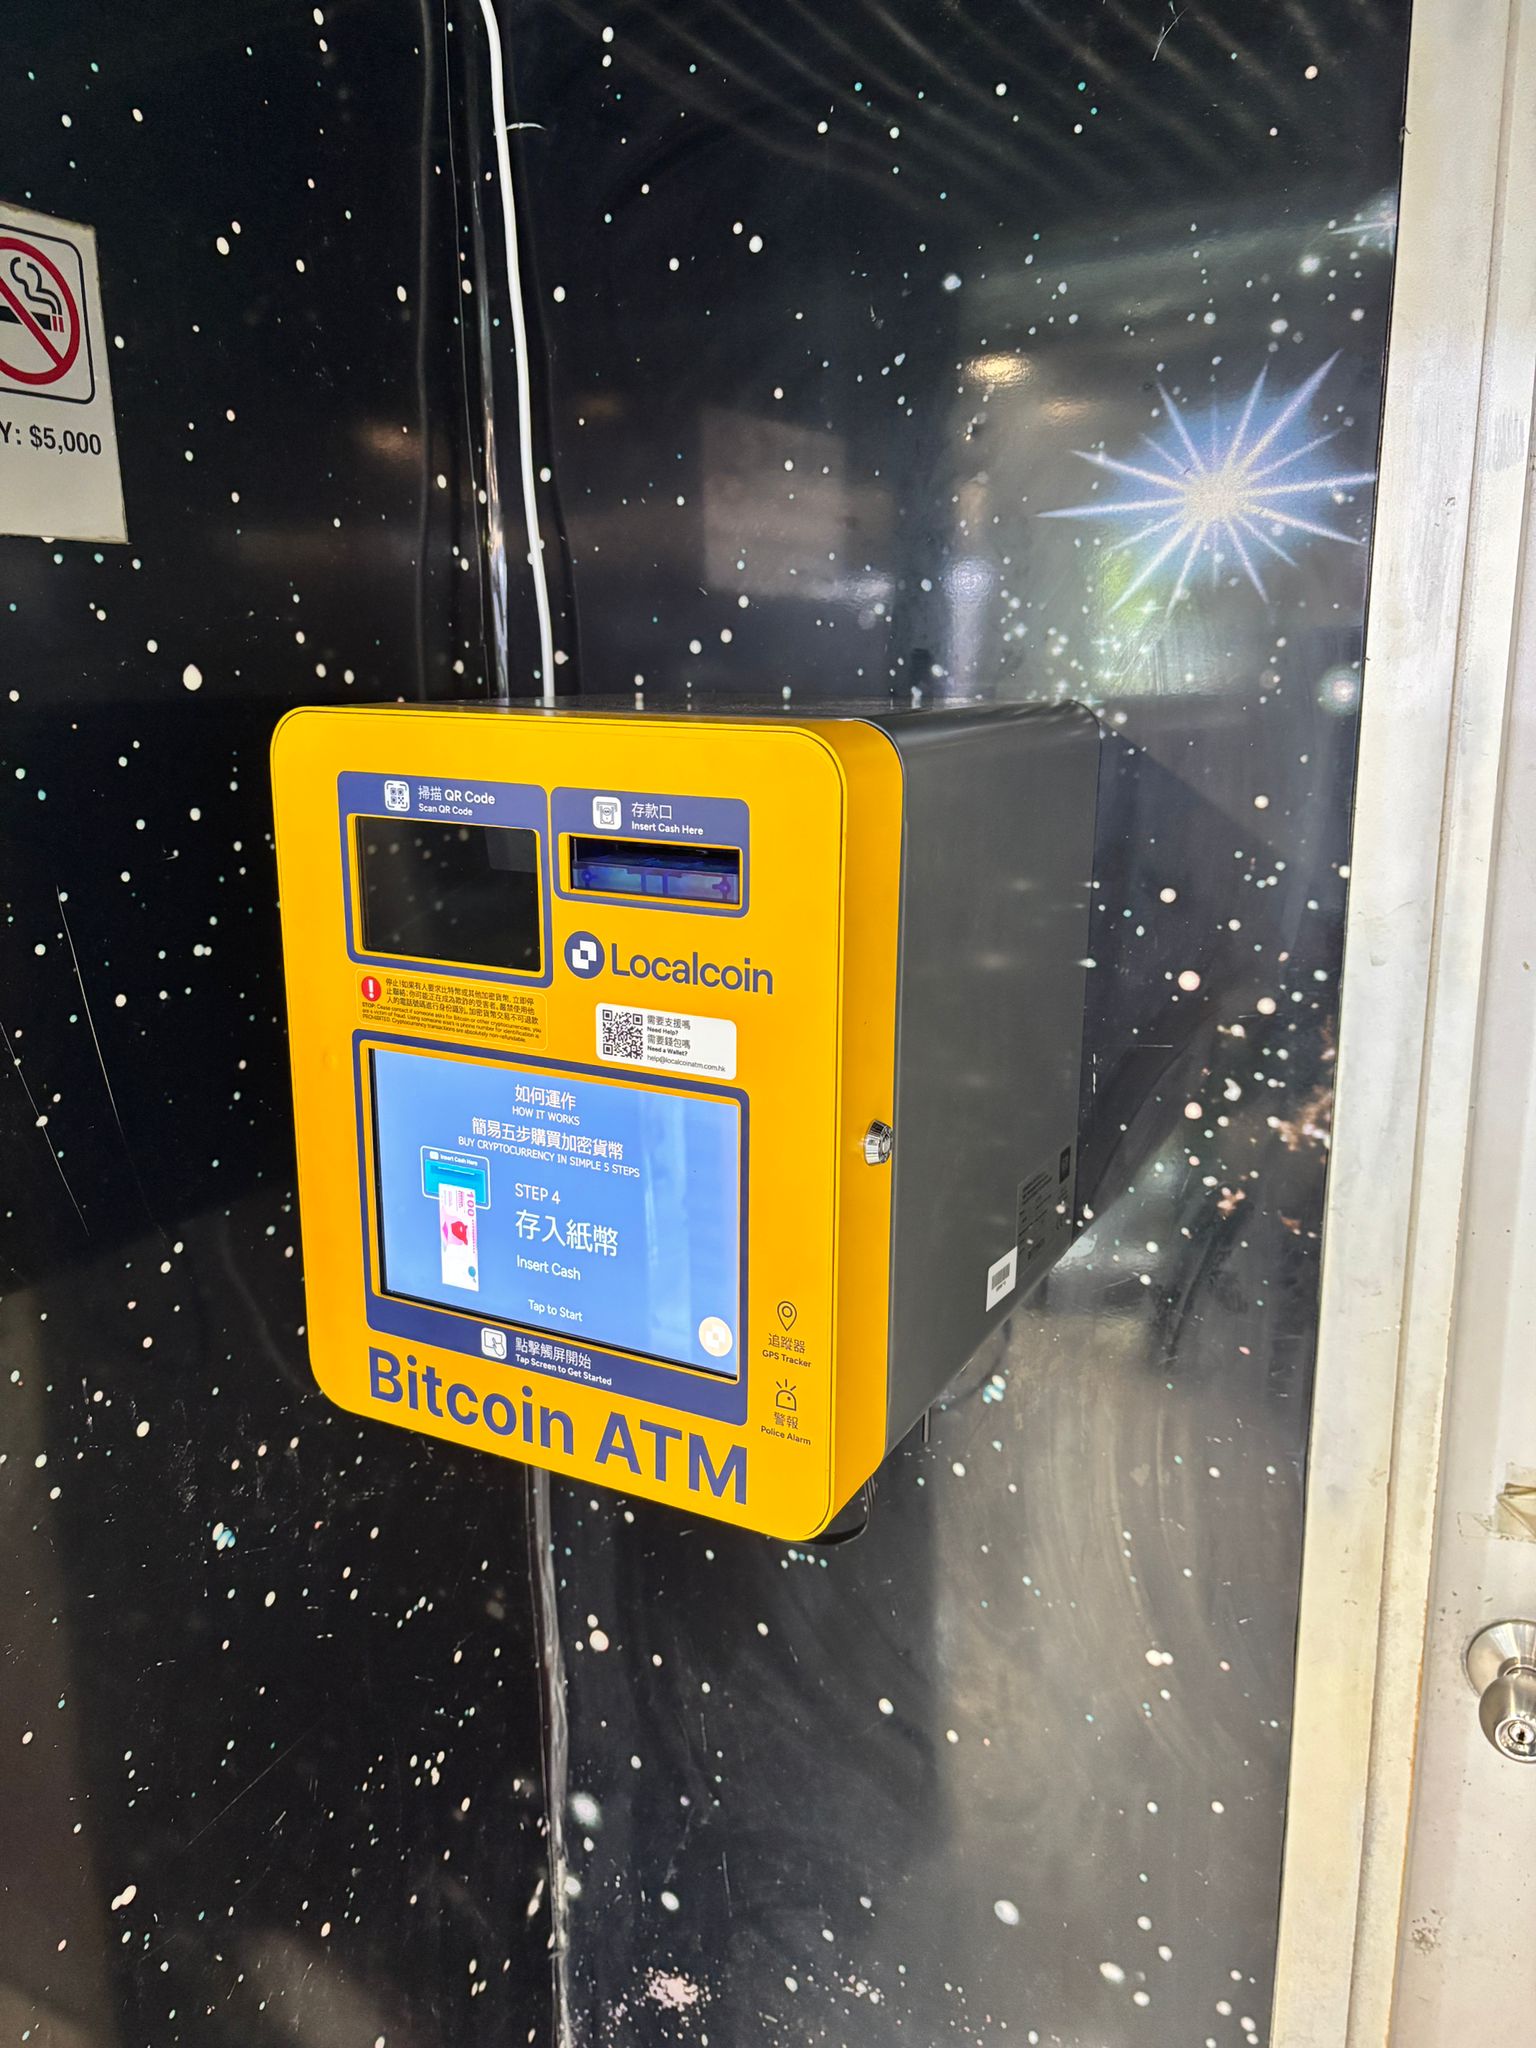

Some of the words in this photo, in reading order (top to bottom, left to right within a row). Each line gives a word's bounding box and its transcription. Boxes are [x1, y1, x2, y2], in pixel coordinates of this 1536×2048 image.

[29, 424, 102, 455] $5,000
[418, 785, 442, 801] 掃描
[444, 789, 463, 803] QR
[464, 790, 496, 805] Code
[418, 803, 437, 813] Scan
[438, 805, 451, 814] QR
[452, 806, 473, 816] Code
[631, 801, 672, 820] 存款口
[631, 820, 656, 832] Insert
[658, 823, 680, 834] Cash
[682, 825, 704, 836] Here
[611, 943, 773, 995] Localcoin
[647, 1014, 691, 1030] 需要支援嗎
[647, 1026, 662, 1034] Need
[663, 1028, 678, 1036] Help?
[647, 1045, 662, 1053] Need
[667, 1048, 688, 1057] Wallet?
[647, 1055, 726, 1073] help@localcoinatm.com.hk
[514, 1084, 576, 1111] 如何運作
[512, 1105, 534, 1118] HOW
[536, 1110, 546, 1120] IT
[547, 1112, 580, 1126] WORKS
[472, 1117, 624, 1160] 簡易五步購買加密貨幣
[458, 1136, 475, 1147] BUY
[477, 1139, 555, 1163] CRYPTOCURRENCY
[557, 1153, 567, 1164] IN
[569, 1156, 601, 1171] SIMPLE
[603, 1162, 610, 1173] 5
[611, 1164, 640, 1178] STEPS
[467, 1191, 475, 1217] 100
[515, 1183, 549, 1202] STEP
[551, 1190, 561, 1205] 4
[515, 1209, 619, 1257] 存入紙幣
[516, 1254, 549, 1273] Insert
[551, 1262, 581, 1281] Cash
[528, 1298, 545, 1314] Tap
[547, 1304, 557, 1316] to
[559, 1306, 583, 1322] Start
[515, 1337, 592, 1370] 點擊觸屏開始
[768, 1333, 806, 1354] 追蹤器
[762, 1349, 780, 1361] GPS
[781, 1353, 812, 1368] Tracker
[515, 1354, 529, 1366] Tap
[530, 1358, 557, 1372] Screen
[558, 1365, 566, 1374] to
[567, 1368, 581, 1378] Get
[583, 1371, 612, 1386] Started
[369, 1347, 575, 1456] Bitcoin
[594, 1411, 748, 1505] ATM
[773, 1411, 799, 1430] 警報
[760, 1425, 785, 1439] Police
[786, 1431, 811, 1446] Alarm
